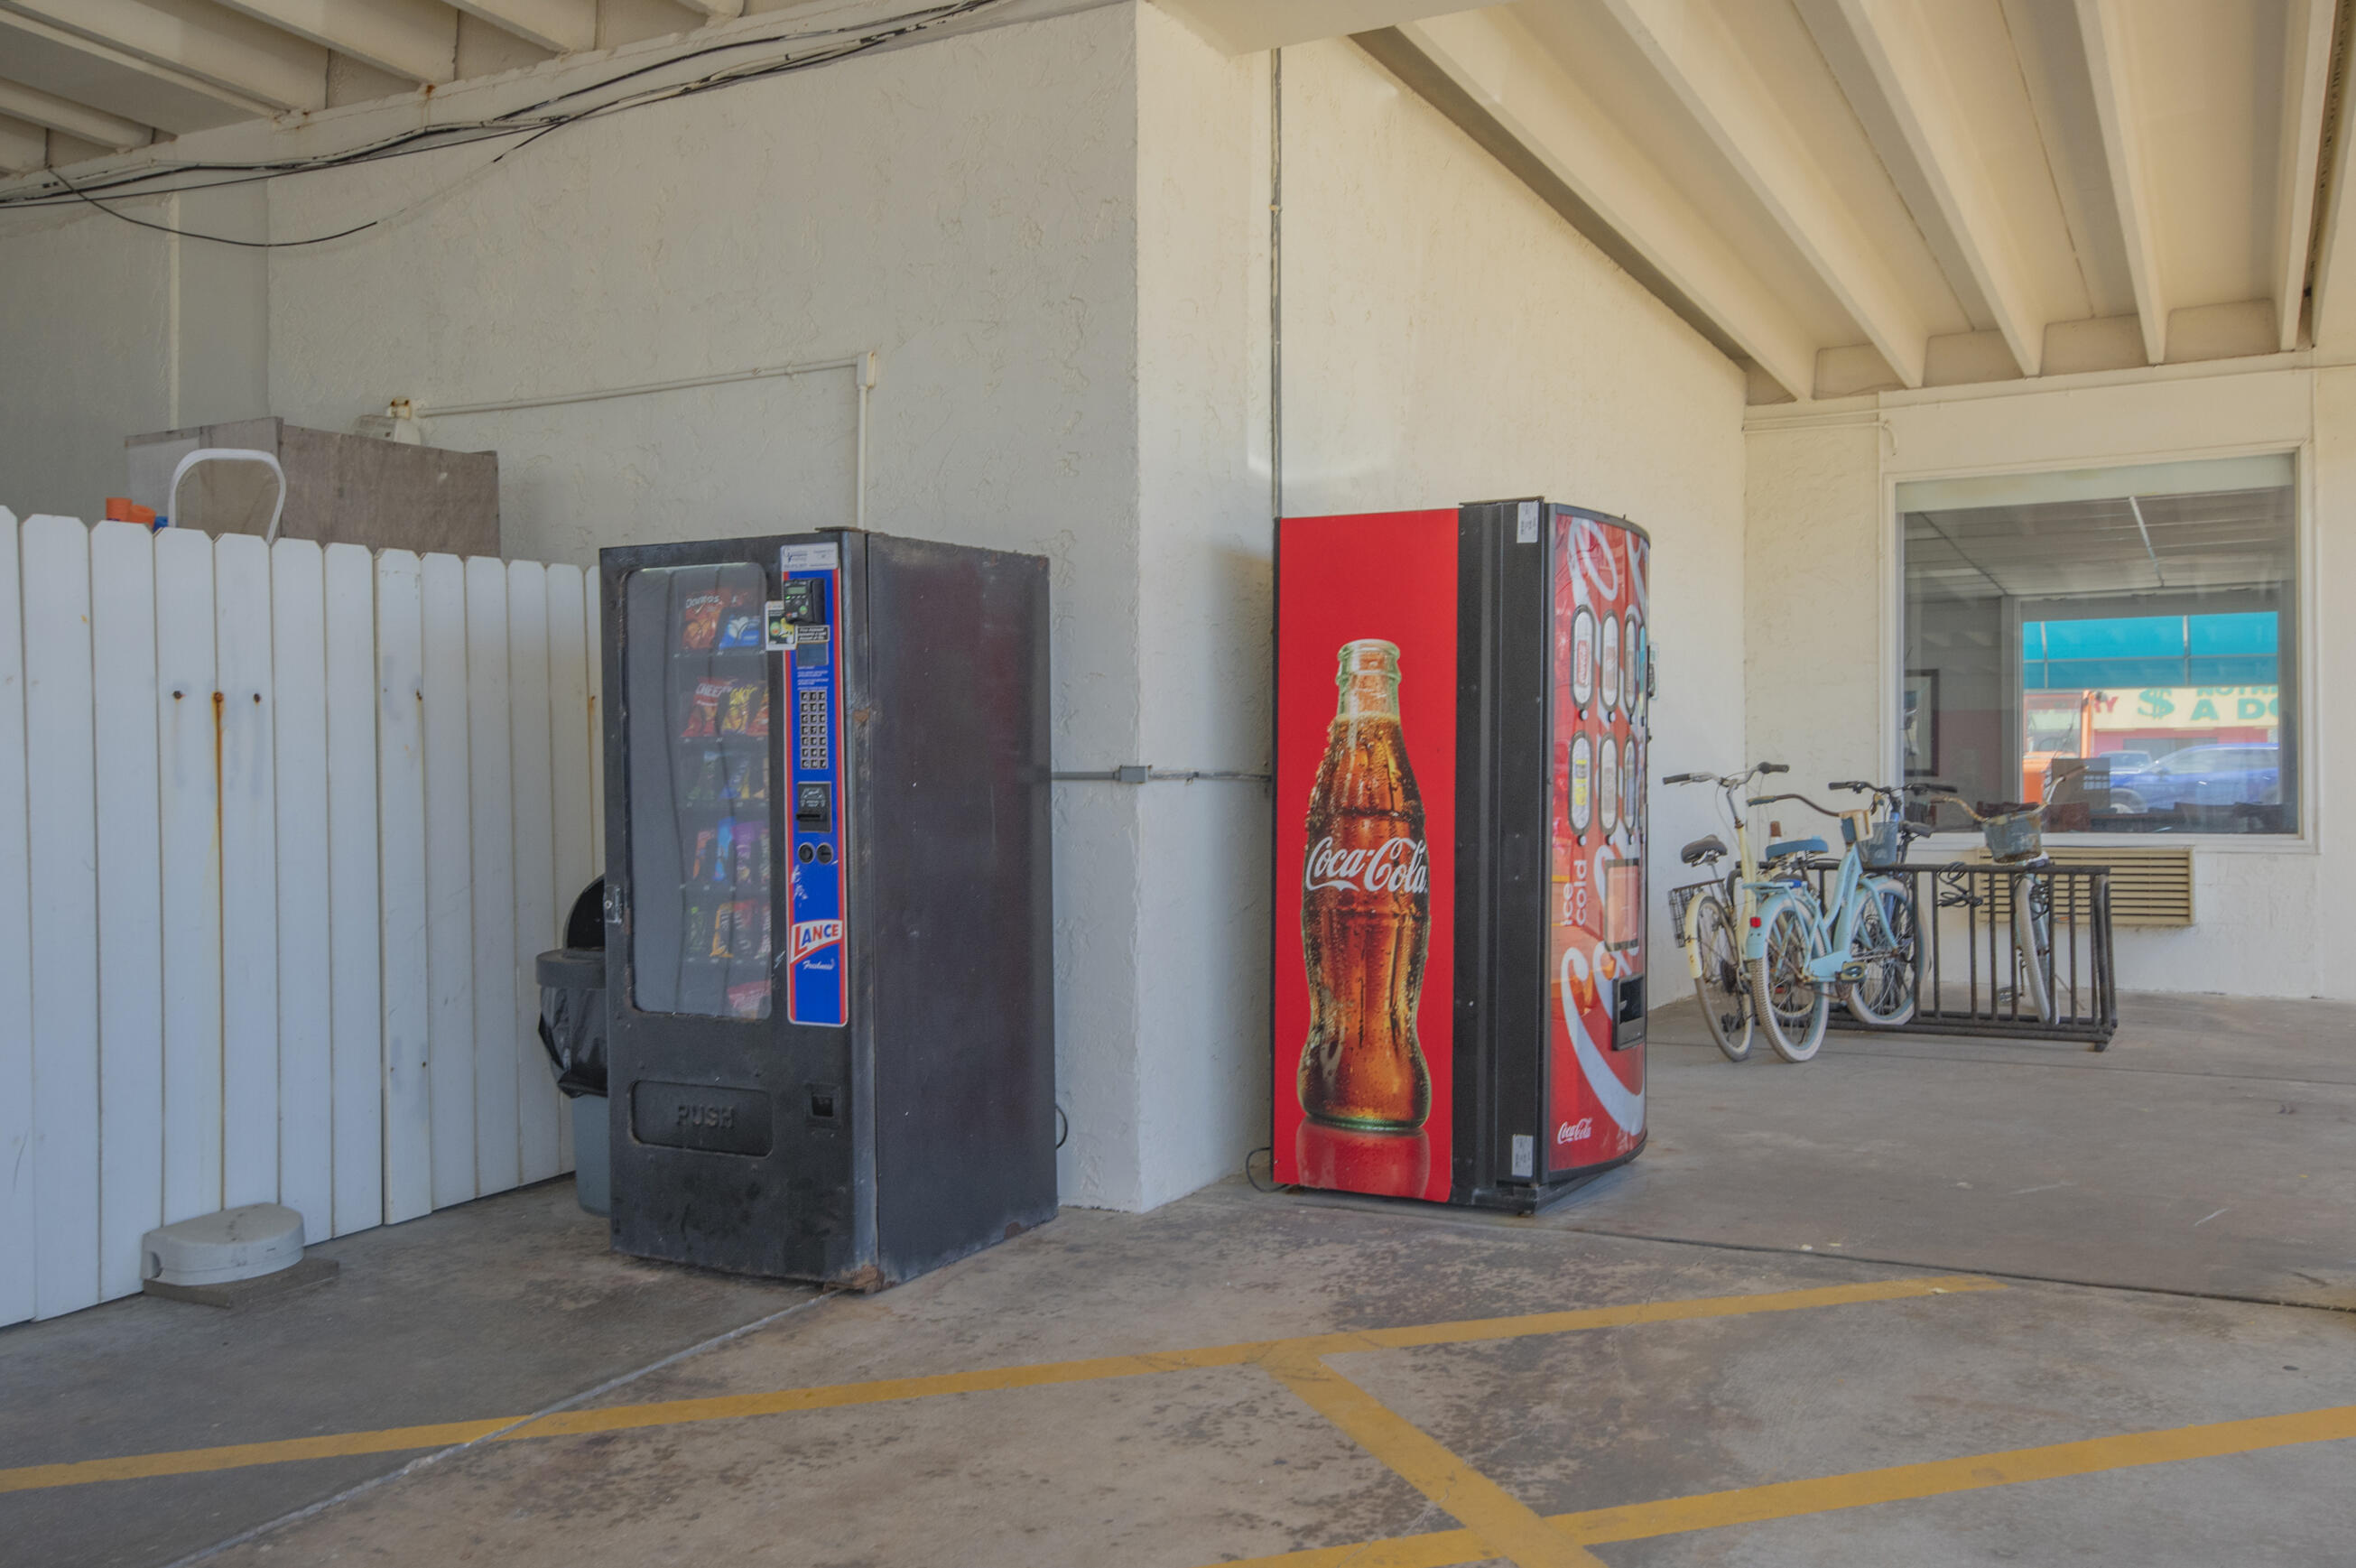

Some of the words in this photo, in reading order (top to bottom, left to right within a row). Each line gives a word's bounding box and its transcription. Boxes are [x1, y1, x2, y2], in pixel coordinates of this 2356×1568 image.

[686, 595, 720, 608] Doritos
[2191, 698, 2219, 720] A
[1306, 836, 1427, 894] Coca-Cola
[1573, 859, 1587, 926] cold
[794, 924, 839, 958] LANCE
[677, 1105, 737, 1128] PUSH
